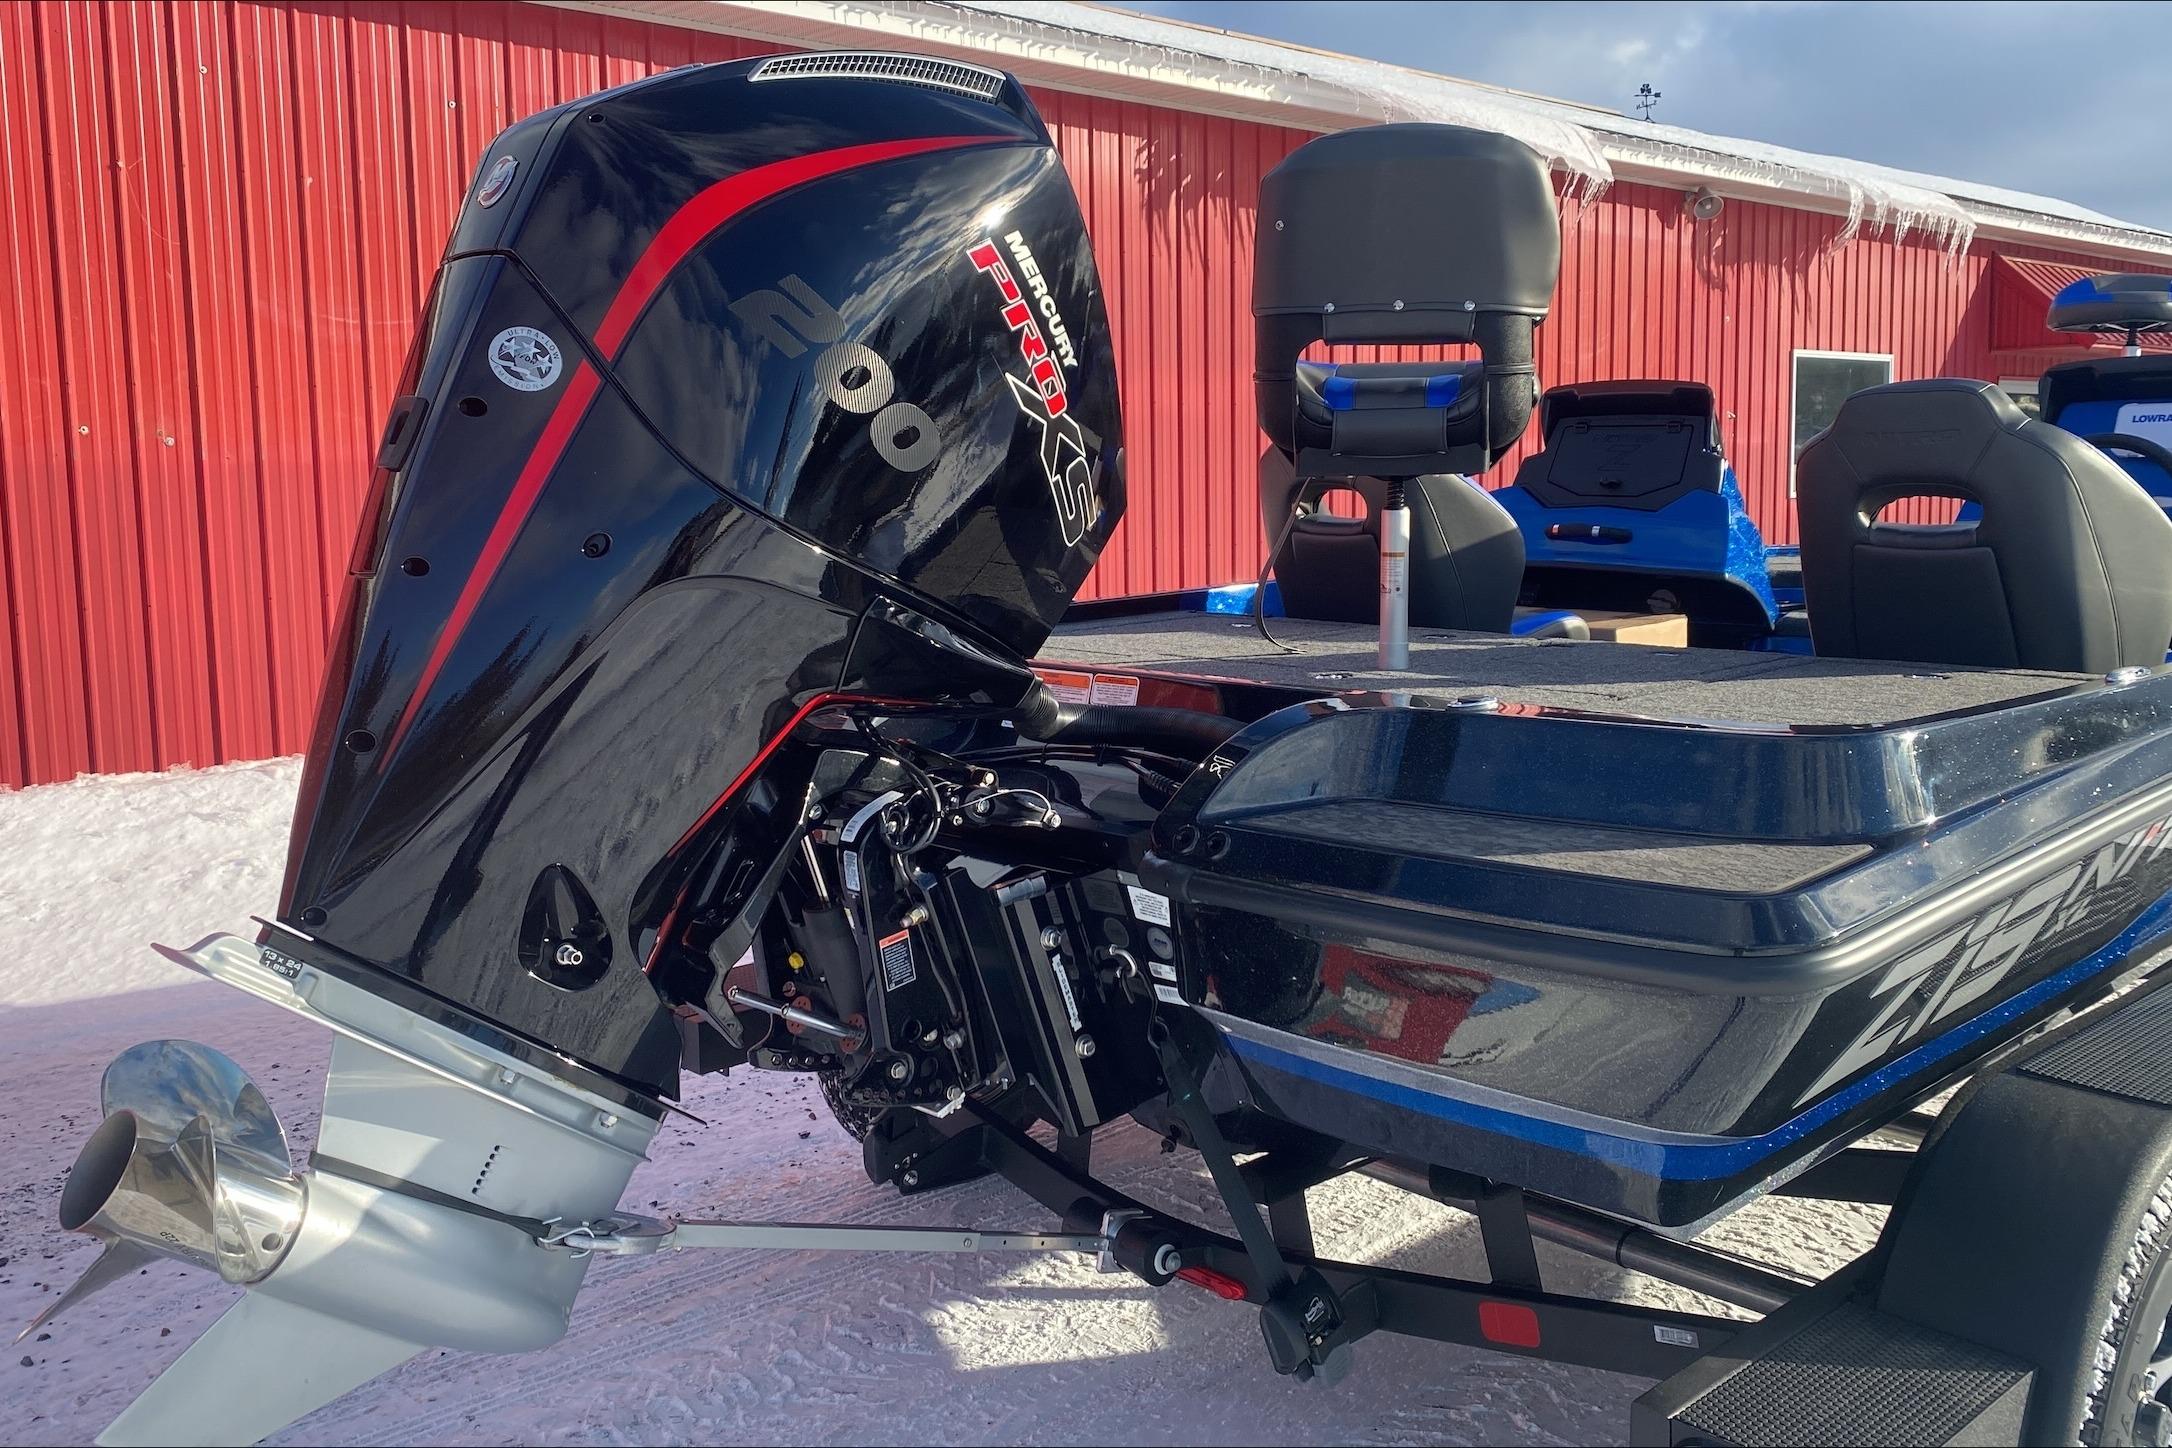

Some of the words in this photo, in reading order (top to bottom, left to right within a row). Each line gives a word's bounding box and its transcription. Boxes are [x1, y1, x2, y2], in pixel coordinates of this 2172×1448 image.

[507, 329, 539, 339] ULTRA
[544, 340, 560, 360] LOW
[728, 274, 942, 473] 200
[966, 237, 1068, 420] PRO
[1004, 229, 1078, 368] MERCURY
[1004, 350, 1097, 547] XS
[264, 950, 278, 961] 13
[285, 959, 302, 971] 24
[1791, 861, 2084, 1110] Z19
